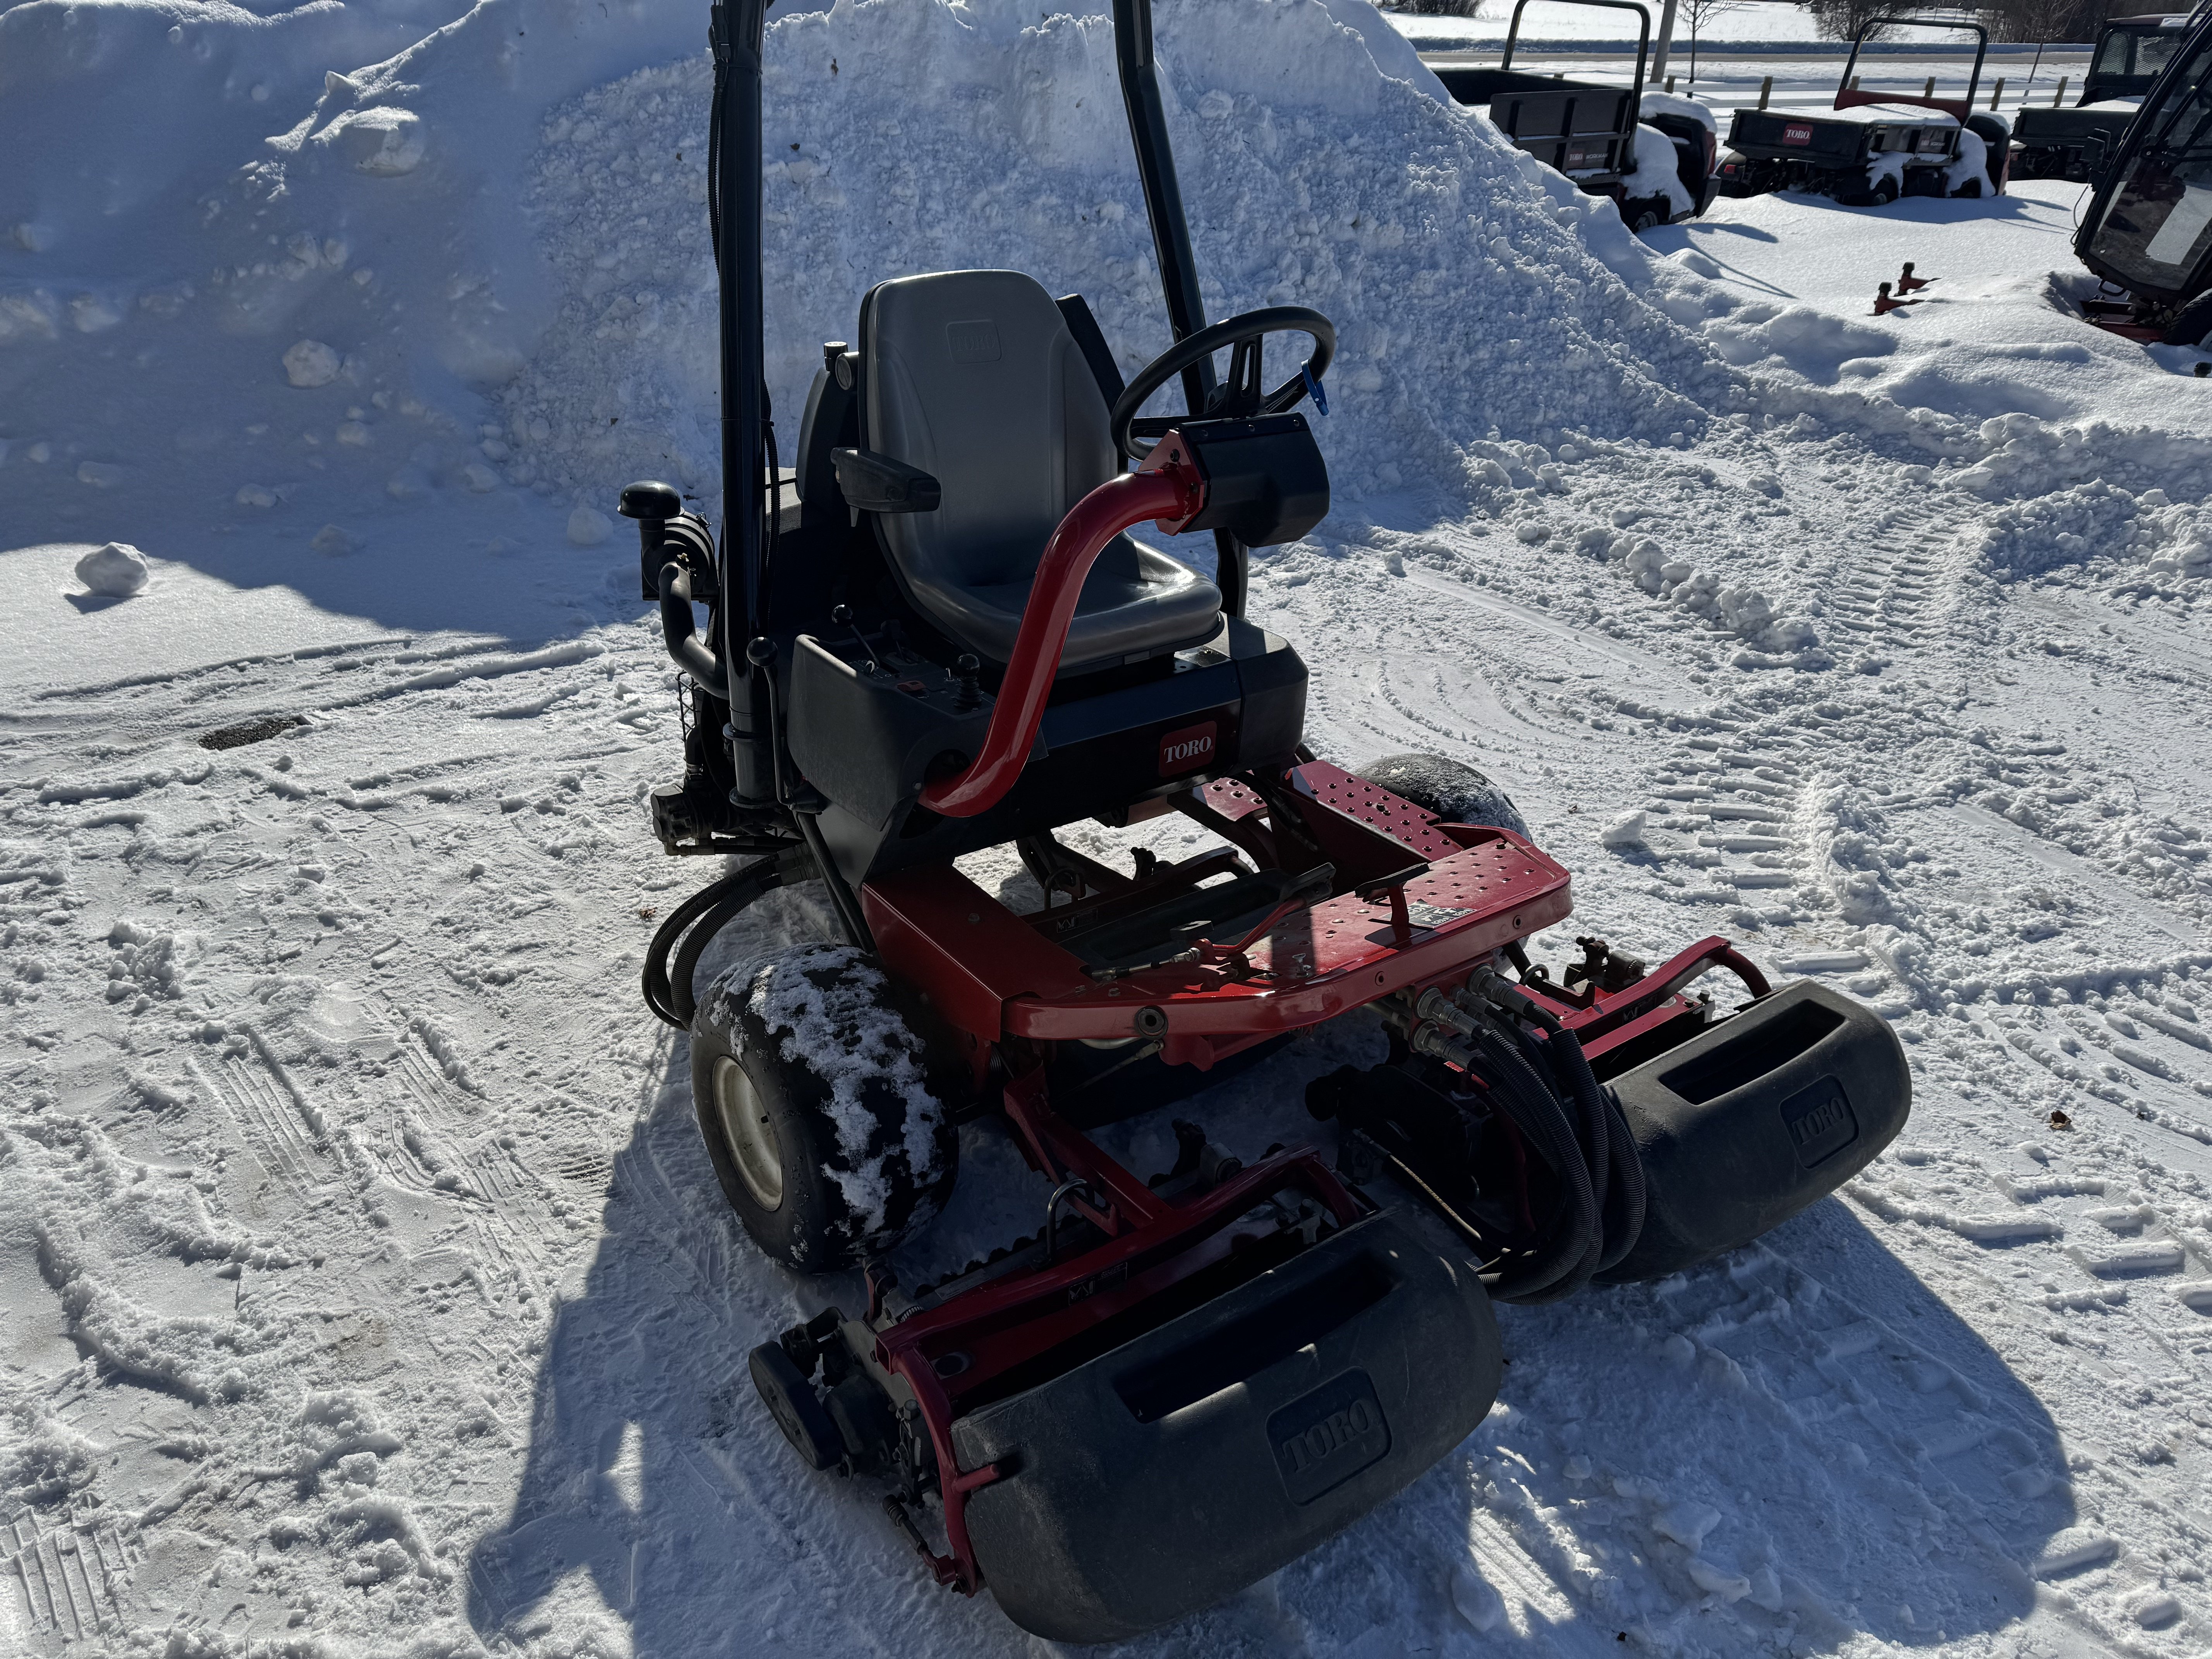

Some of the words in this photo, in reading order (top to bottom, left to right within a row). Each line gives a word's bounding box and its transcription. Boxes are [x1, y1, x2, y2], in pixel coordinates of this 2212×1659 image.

[1786, 129, 1810, 139] TORO
[949, 334, 995, 351] TORO
[1164, 736, 1212, 763] TORO
[1791, 1097, 1844, 1145] TORO
[1281, 1399, 1371, 1472] TORO
